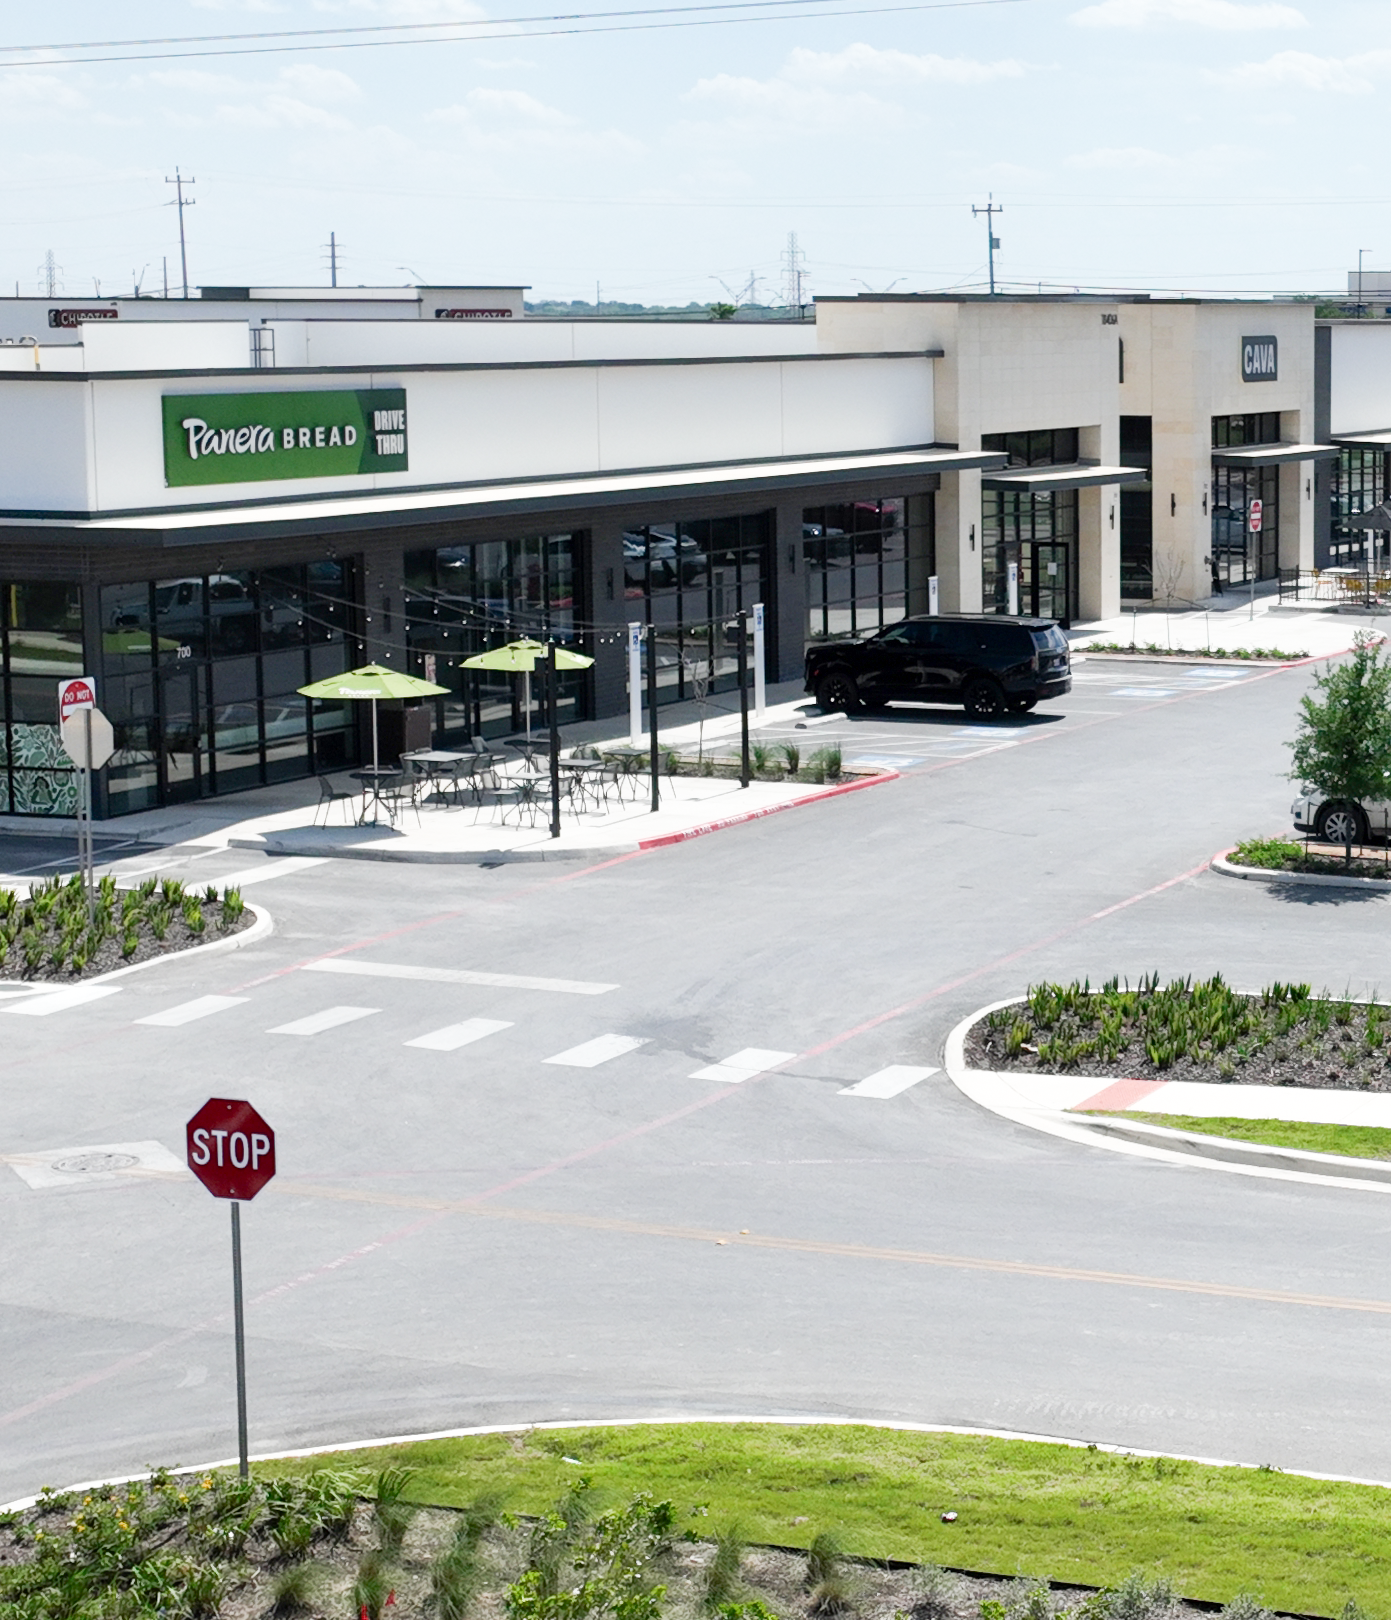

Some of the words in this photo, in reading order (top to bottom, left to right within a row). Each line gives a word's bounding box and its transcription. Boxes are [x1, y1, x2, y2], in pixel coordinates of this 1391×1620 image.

[1244, 344, 1276, 374] CAVA
[373, 410, 405, 431] DRIVE
[182, 418, 275, 460] Panera
[283, 425, 357, 449] BREAD
[375, 434, 405, 455] THRU
[176, 645, 191, 659] 700
[64, 691, 75, 703] DO
[76, 689, 90, 700] NOT
[192, 1128, 271, 1170] STOP
